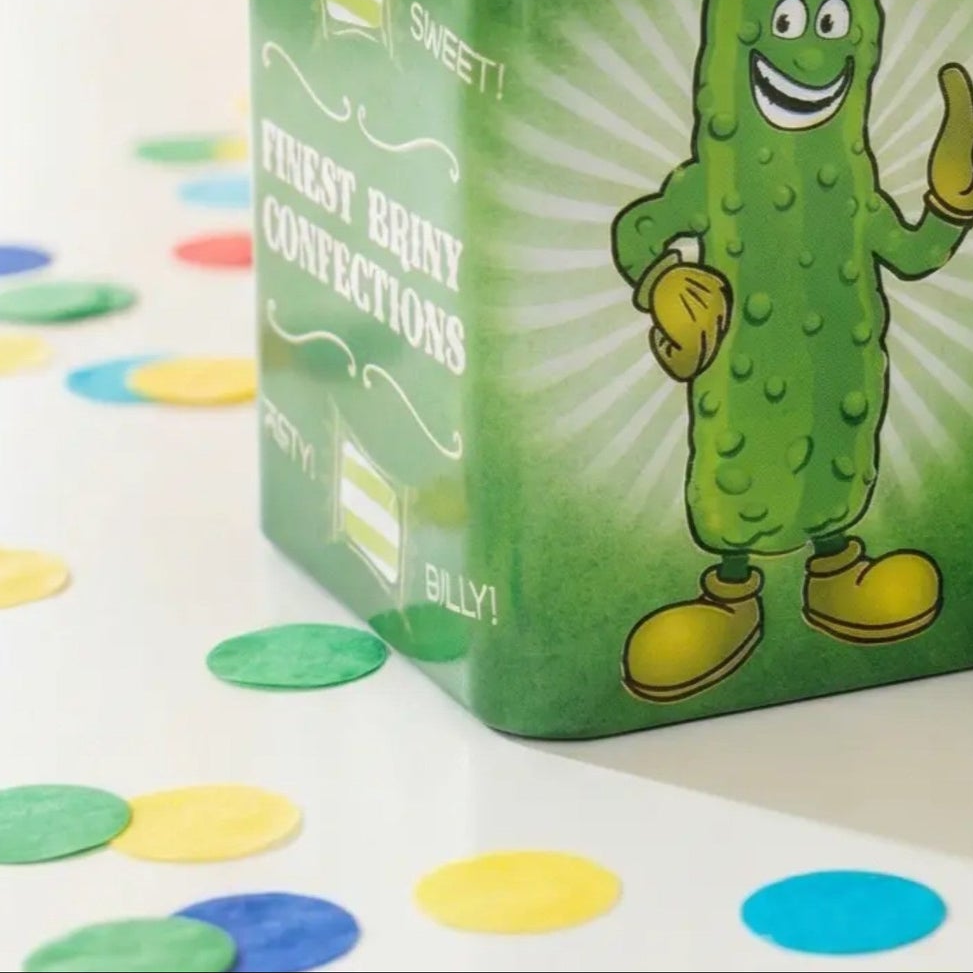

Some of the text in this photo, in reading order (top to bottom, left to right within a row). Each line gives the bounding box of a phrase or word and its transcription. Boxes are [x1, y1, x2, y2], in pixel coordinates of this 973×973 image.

[410, 2, 505, 101] SWEET!
[261, 119, 463, 293] FINEST BRINY
[263, 194, 466, 375] CONFECTIONS
